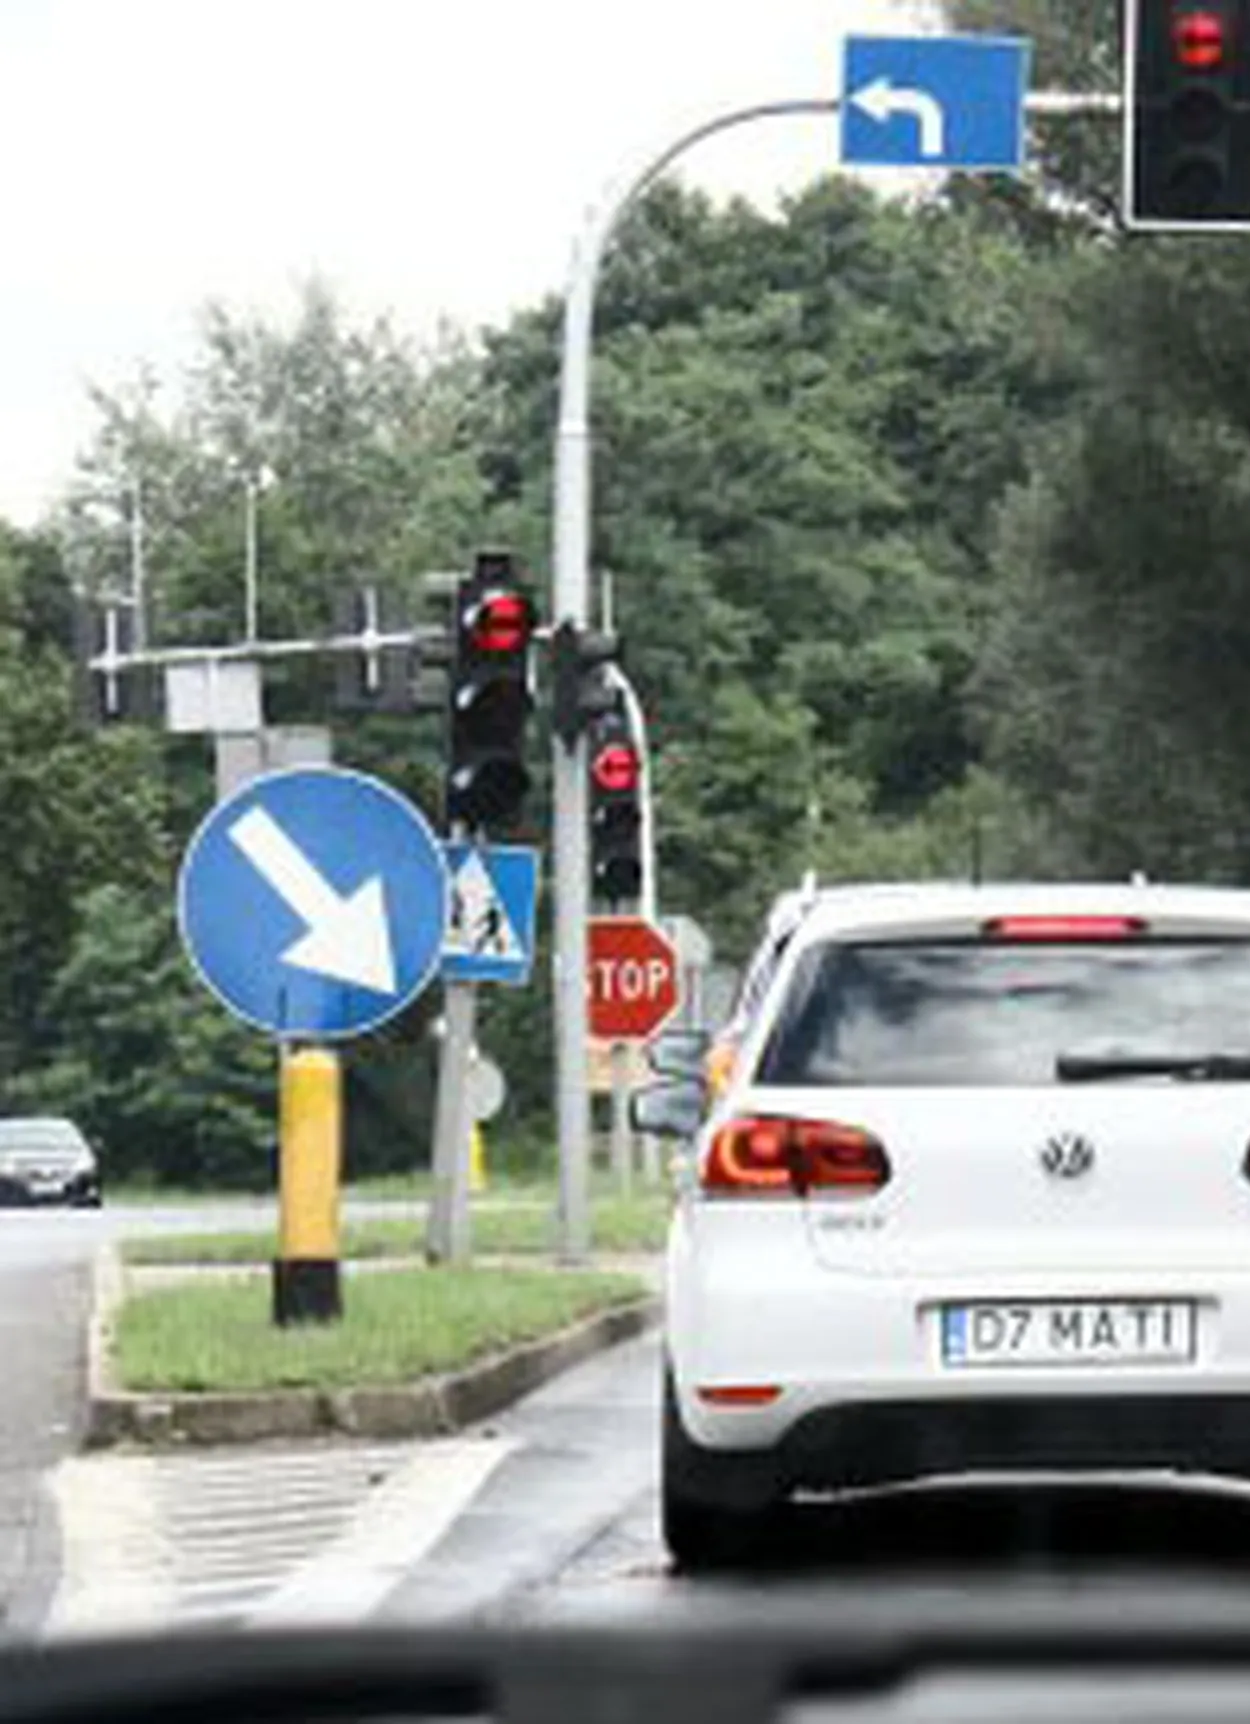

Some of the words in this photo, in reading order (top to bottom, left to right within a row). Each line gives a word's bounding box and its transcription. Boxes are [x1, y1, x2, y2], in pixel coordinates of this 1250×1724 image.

[585, 958, 670, 1001] TOP
[972, 1307, 1032, 1352] D7
[1050, 1306, 1173, 1350] MATI
